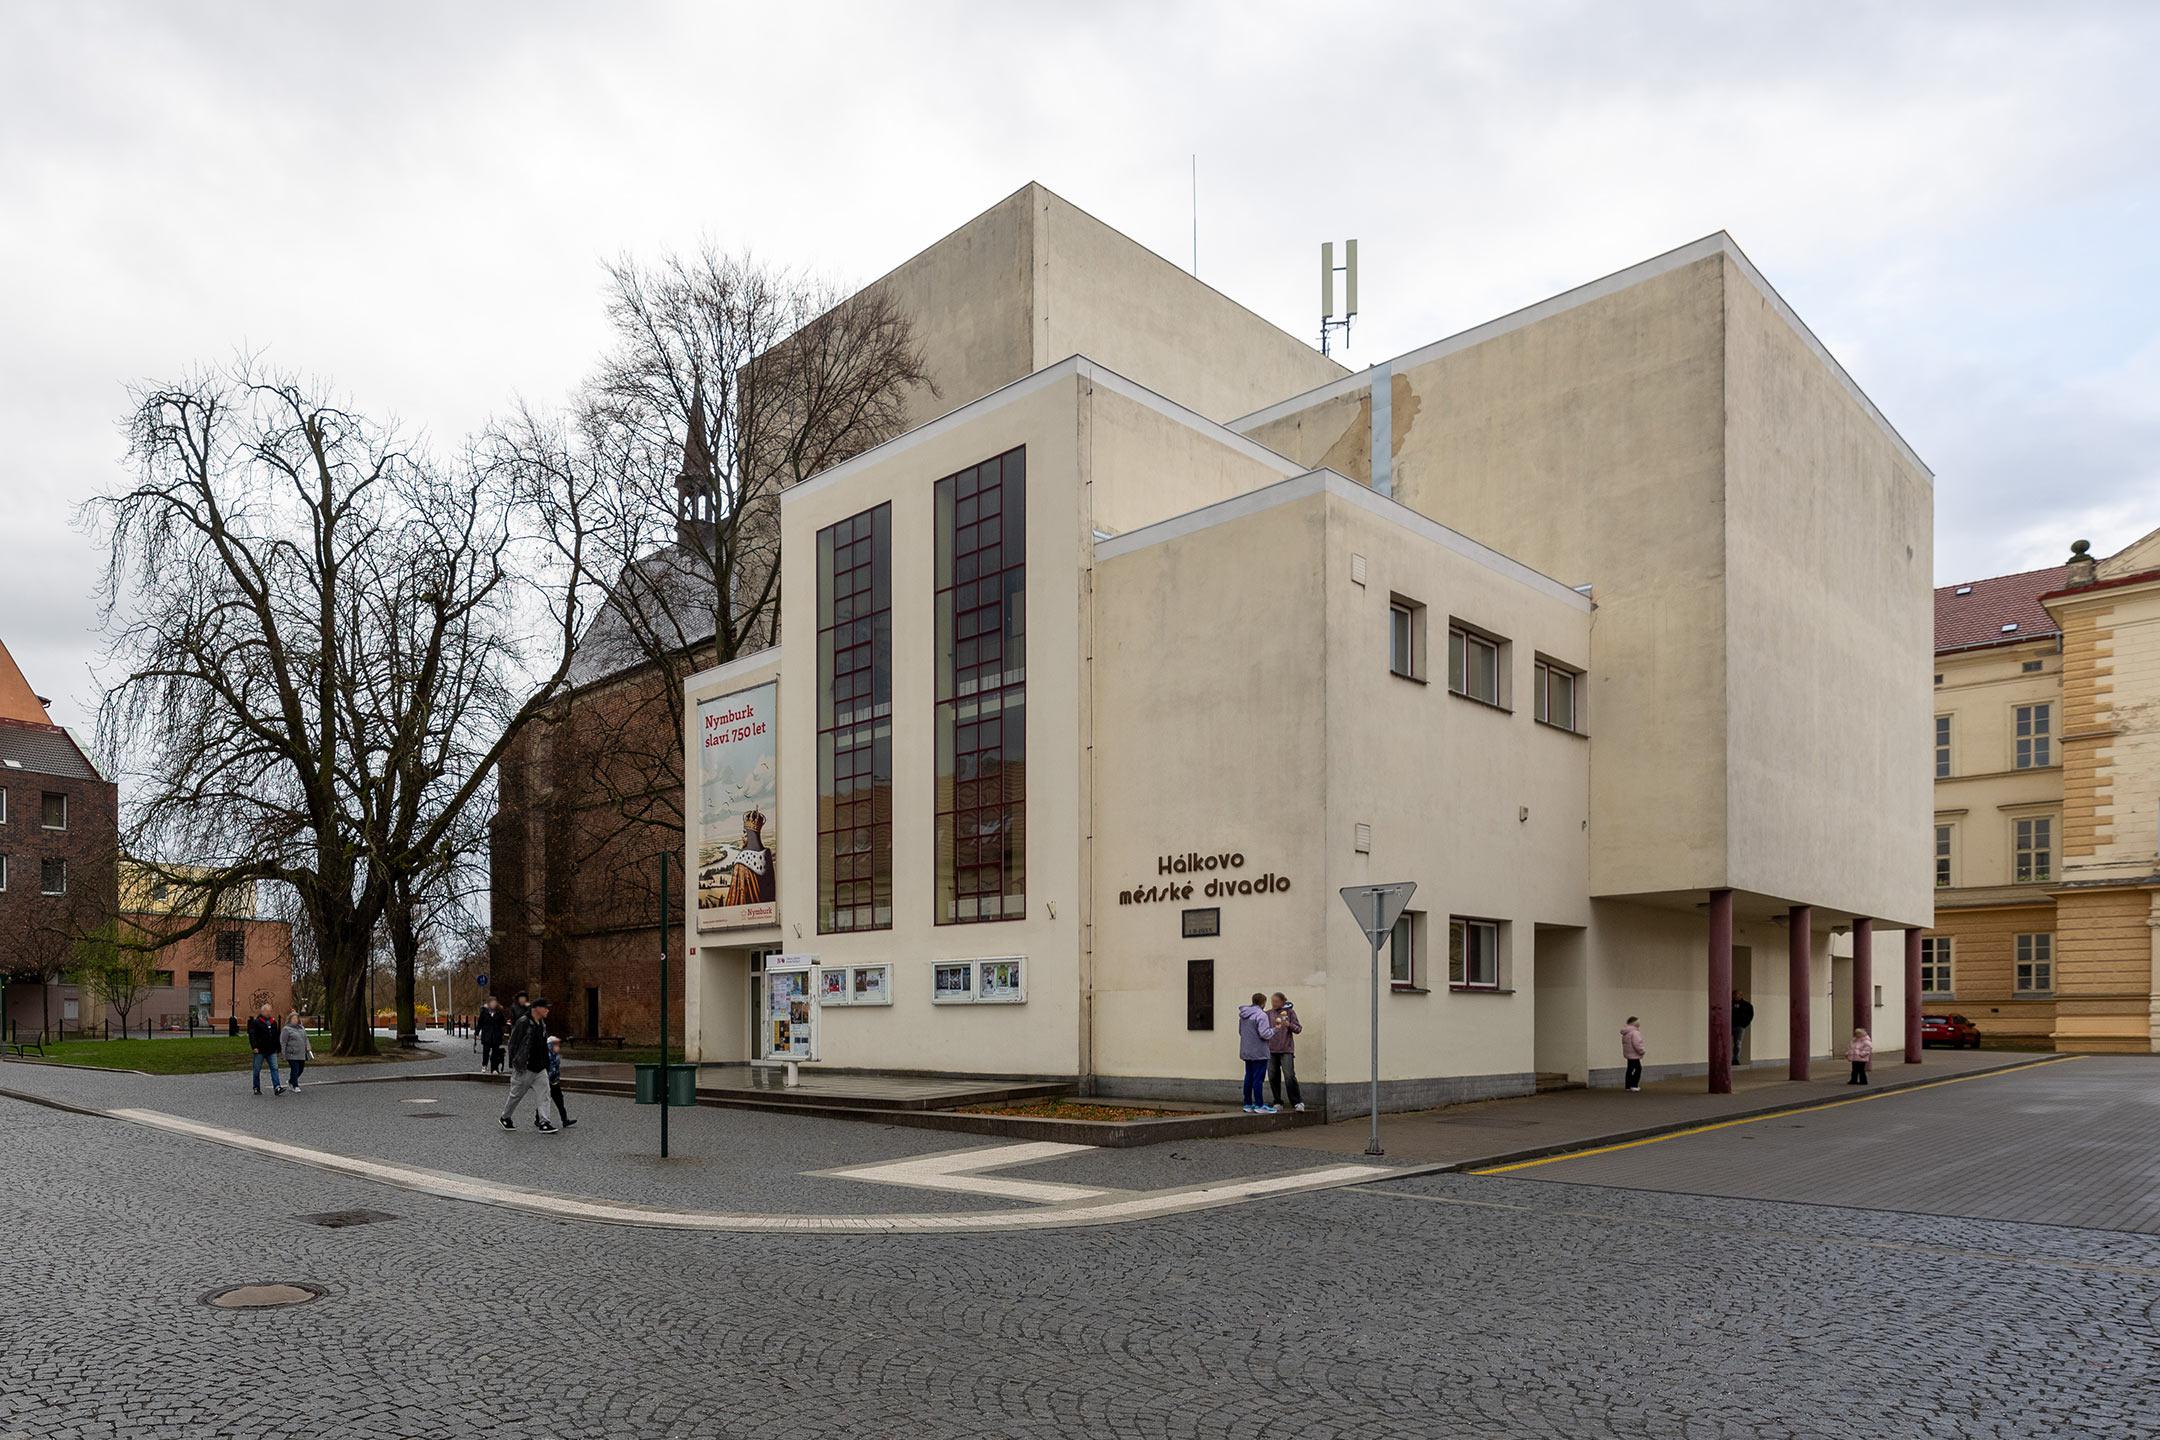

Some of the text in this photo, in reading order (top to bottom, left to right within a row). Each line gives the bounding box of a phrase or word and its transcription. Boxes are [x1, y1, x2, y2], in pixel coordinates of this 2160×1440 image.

[705, 705, 754, 730] Nymburk
[705, 721, 767, 748] slaví 750 let
[1158, 852, 1245, 875] Hálkovo
[1204, 873, 1291, 898] divadlo
[747, 906, 773, 917] Nymburk
